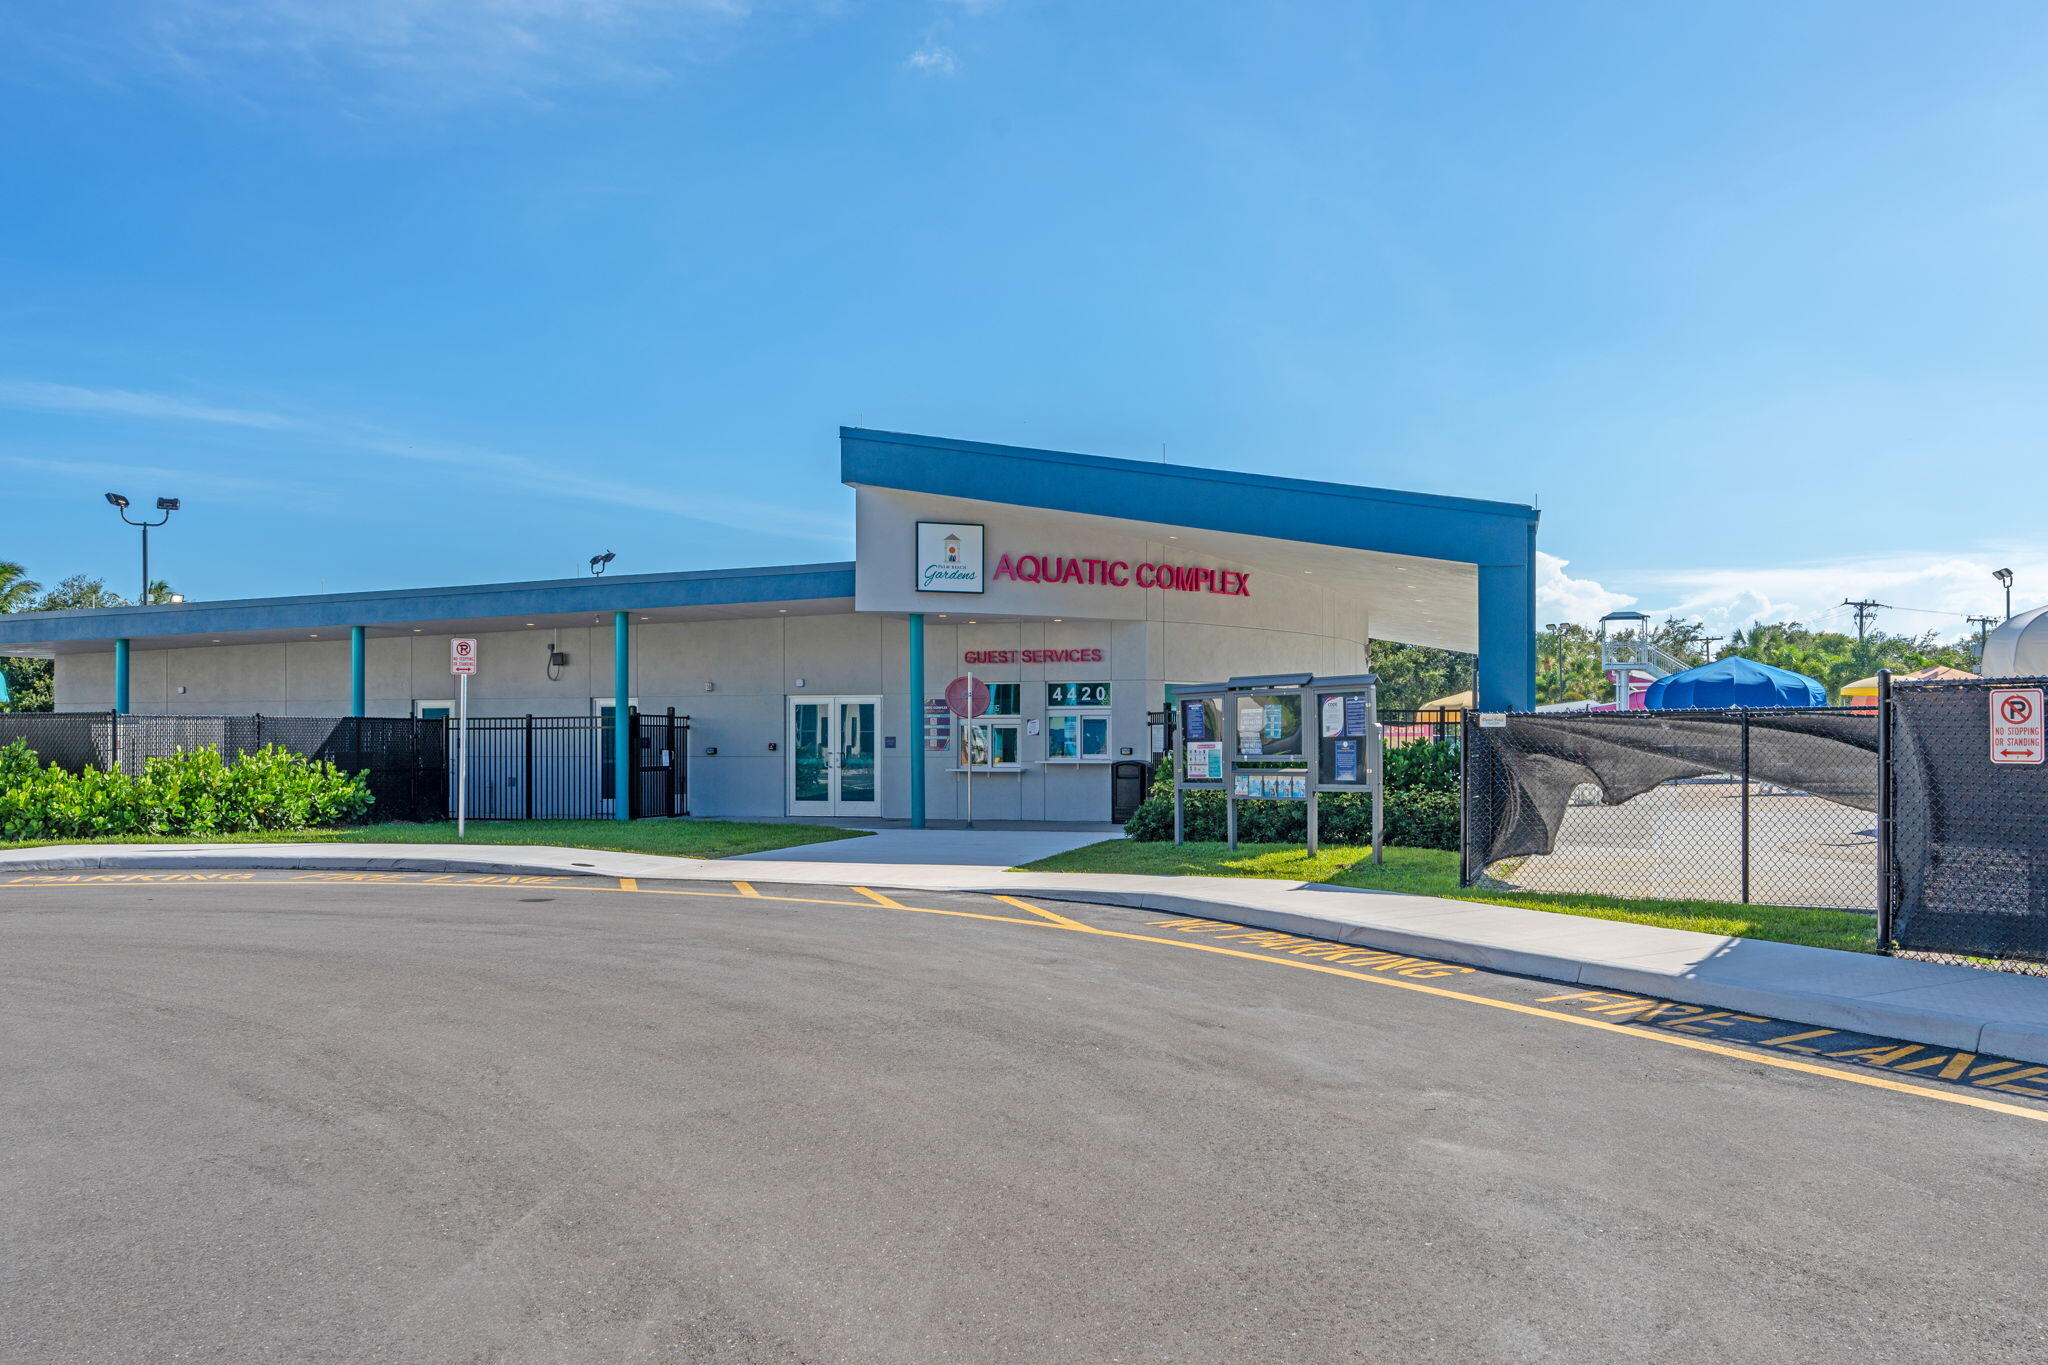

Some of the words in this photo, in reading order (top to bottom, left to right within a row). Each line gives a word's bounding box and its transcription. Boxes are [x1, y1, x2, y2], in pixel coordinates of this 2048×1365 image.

[924, 564, 977, 587] Gardens
[993, 554, 1129, 587] AQUATIC
[1136, 563, 1251, 597] COMPLEX
[964, 650, 1017, 665] GUEST
[1021, 649, 1102, 664] SERVICES
[1052, 686, 1106, 701] 4420
[1995, 727, 2005, 735] NO
[2007, 727, 2040, 735] STOPPING
[1995, 738, 2004, 746] OR
[2007, 738, 2040, 746] STANDING
[288, 873, 422, 882] FIRE
[422, 875, 573, 884] LANE
[1143, 919, 1245, 932] NO
[1215, 931, 1477, 979] PARKING
[1534, 990, 1772, 1033] FIRE
[1758, 1029, 2048, 1096] LANE
